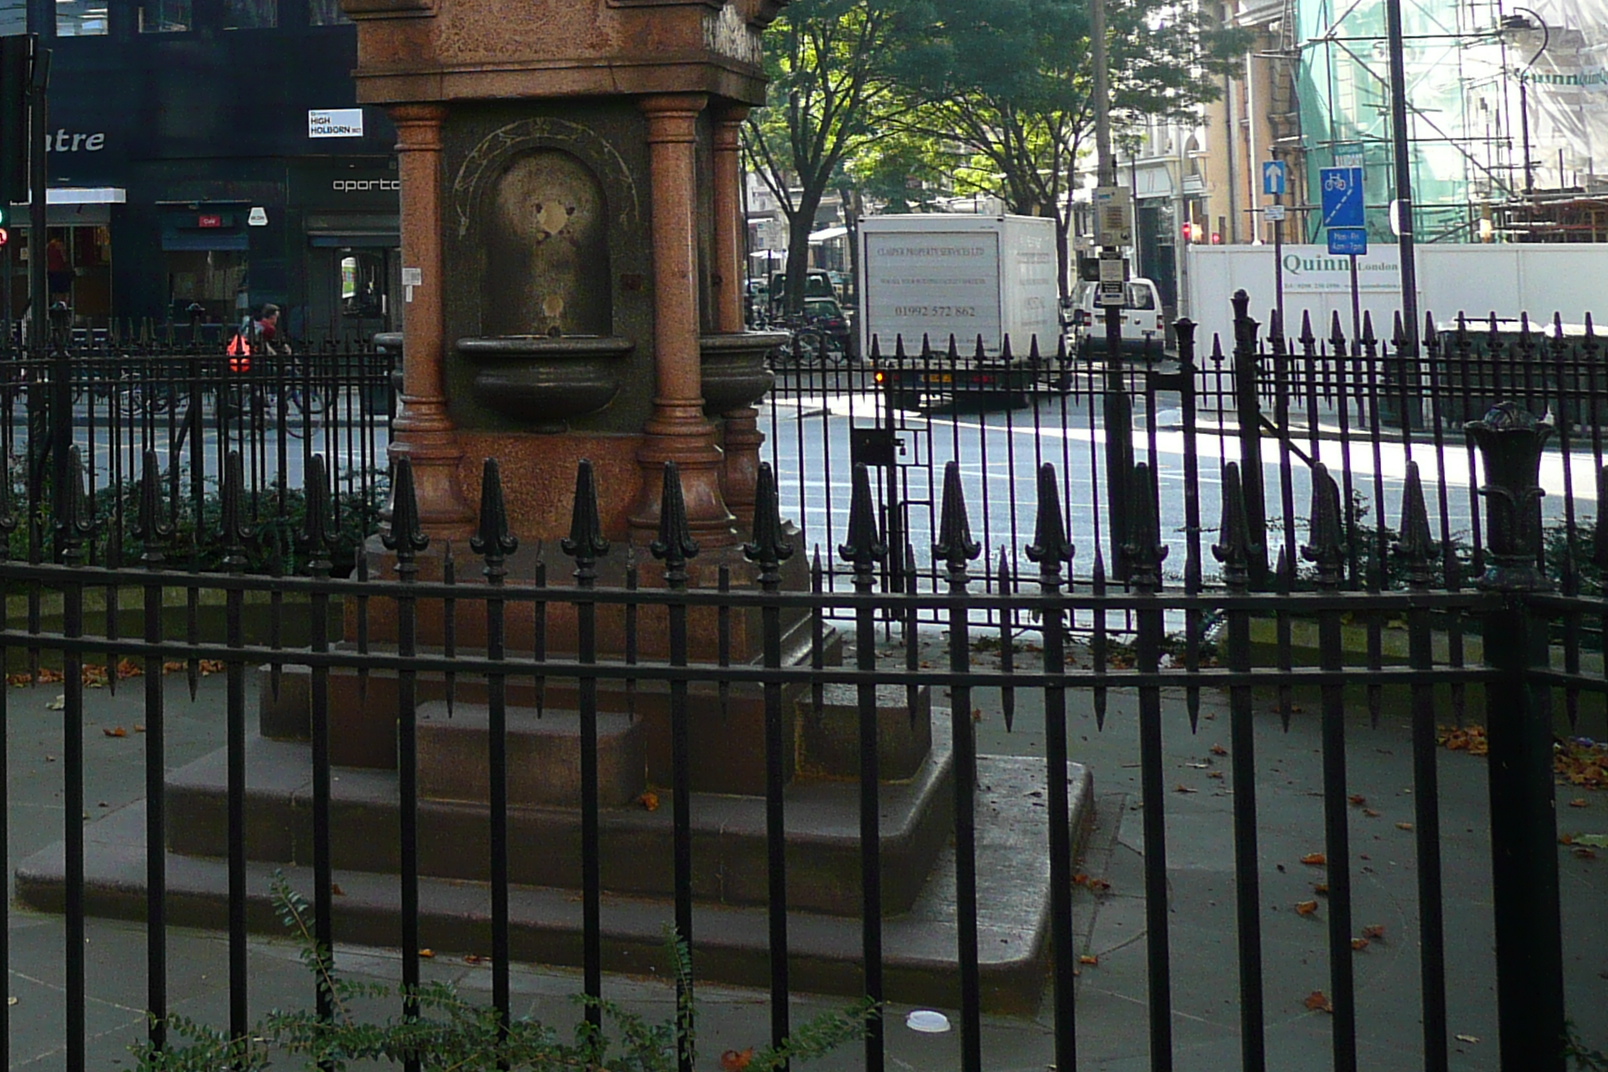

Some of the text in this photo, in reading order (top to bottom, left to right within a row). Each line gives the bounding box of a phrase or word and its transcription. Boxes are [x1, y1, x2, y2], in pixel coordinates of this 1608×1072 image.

[311, 117, 330, 125] HIGH
[311, 126, 351, 134] HOLBORN
[1283, 254, 1398, 275] Quinn London
[894, 306, 976, 318] 01992 572 862
